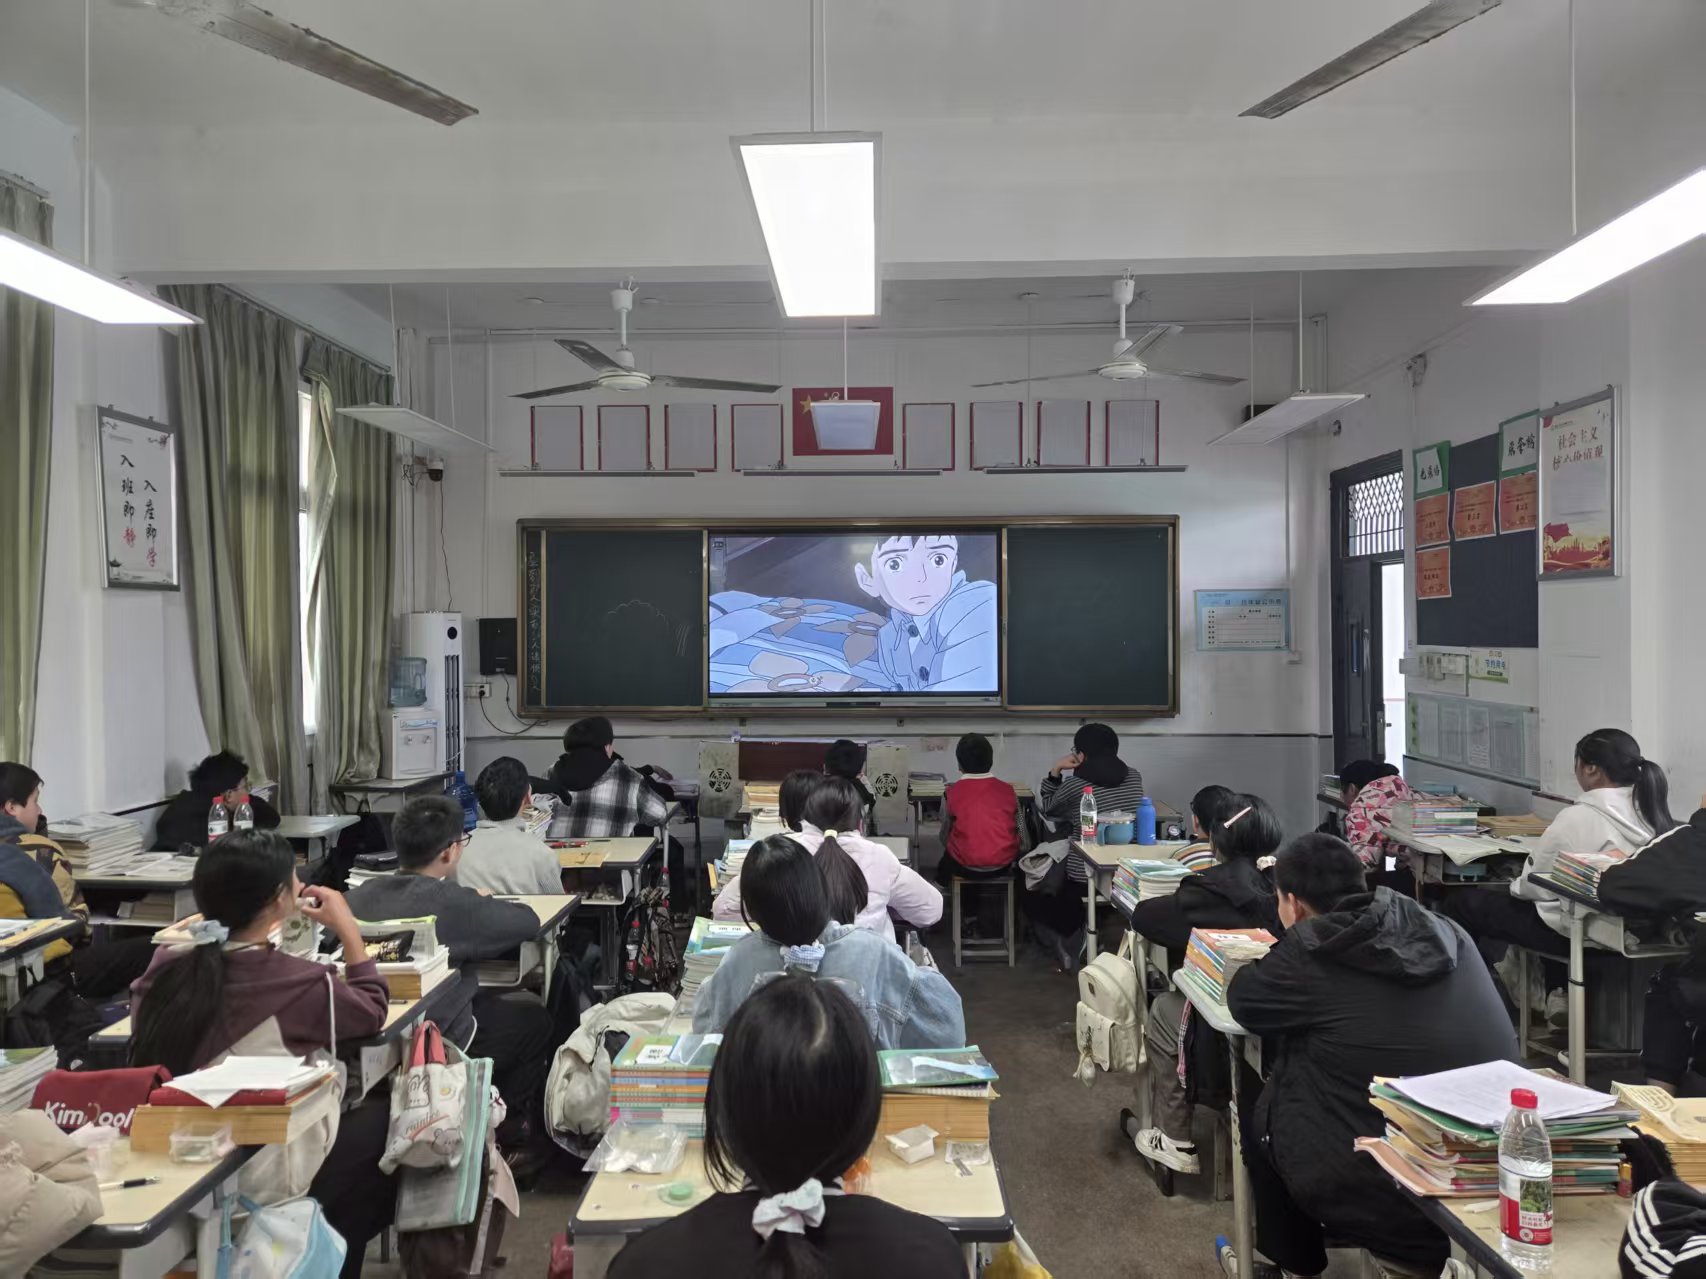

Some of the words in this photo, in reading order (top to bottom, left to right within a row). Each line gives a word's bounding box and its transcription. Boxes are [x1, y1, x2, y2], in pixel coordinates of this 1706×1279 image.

[1557, 426, 1598, 450] 社会主义
[120, 454, 136, 548] 入班即静
[143, 479, 158, 568] 入座即学
